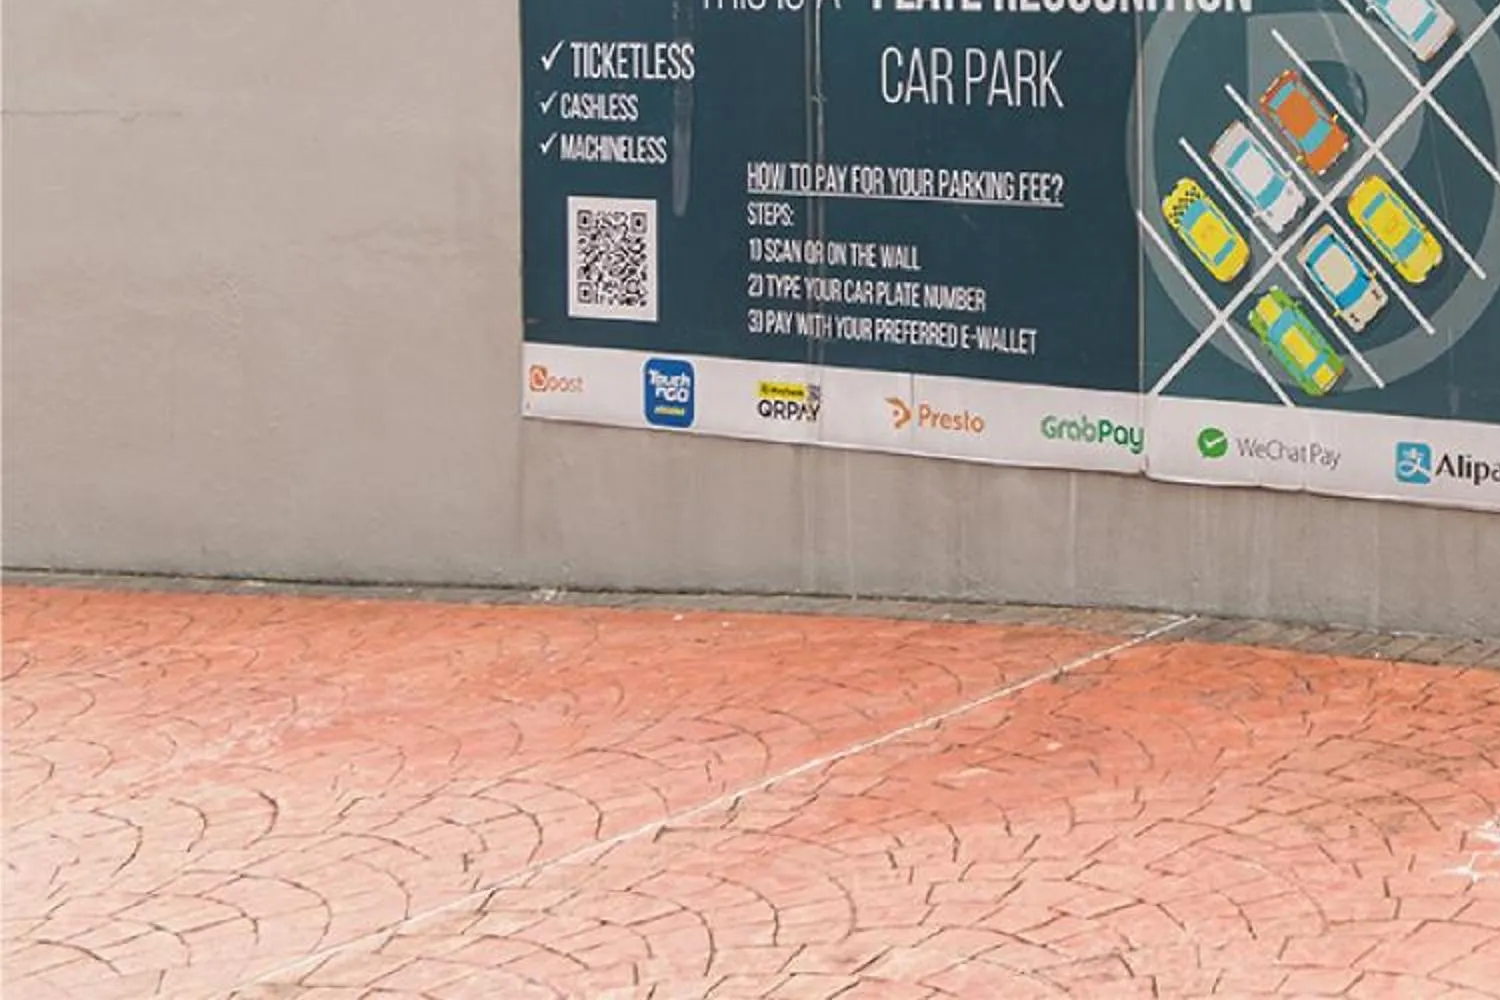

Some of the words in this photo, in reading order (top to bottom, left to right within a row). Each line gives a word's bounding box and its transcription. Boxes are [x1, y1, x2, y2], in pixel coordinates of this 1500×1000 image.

[570, 41, 695, 80] TICKETLESS
[881, 46, 954, 105] CAR
[965, 47, 1064, 108] PARK
[560, 92, 639, 121] CASHLESS
[560, 133, 667, 164] MACHINELESS
[747, 161, 787, 190] HOW
[789, 162, 813, 192] TO
[815, 164, 847, 193] PAY
[851, 164, 885, 195] FOR
[887, 166, 933, 197] YOUR
[938, 168, 1015, 201] PARKING
[1018, 170, 1064, 204] FEE?
[747, 201, 795, 227] STEPS:
[763, 237, 801, 263] SCAN
[827, 240, 847, 266] ON
[849, 242, 877, 268] THE
[879, 243, 922, 271] WALL
[765, 274, 801, 299] TYPE
[803, 276, 842, 302] YOUR
[844, 279, 873, 304] CAR
[875, 281, 920, 307] PLATE
[923, 284, 987, 312] NUMBER
[765, 309, 793, 334] PAY
[795, 311, 833, 338] WITH
[835, 316, 873, 341] YOUR
[875, 317, 958, 348] PREFERRED
[960, 324, 1037, 356] E-WALLET
[757, 398, 821, 423] QRPAY
[918, 402, 986, 433] Presto
[1041, 414, 1145, 455] GrabPay
